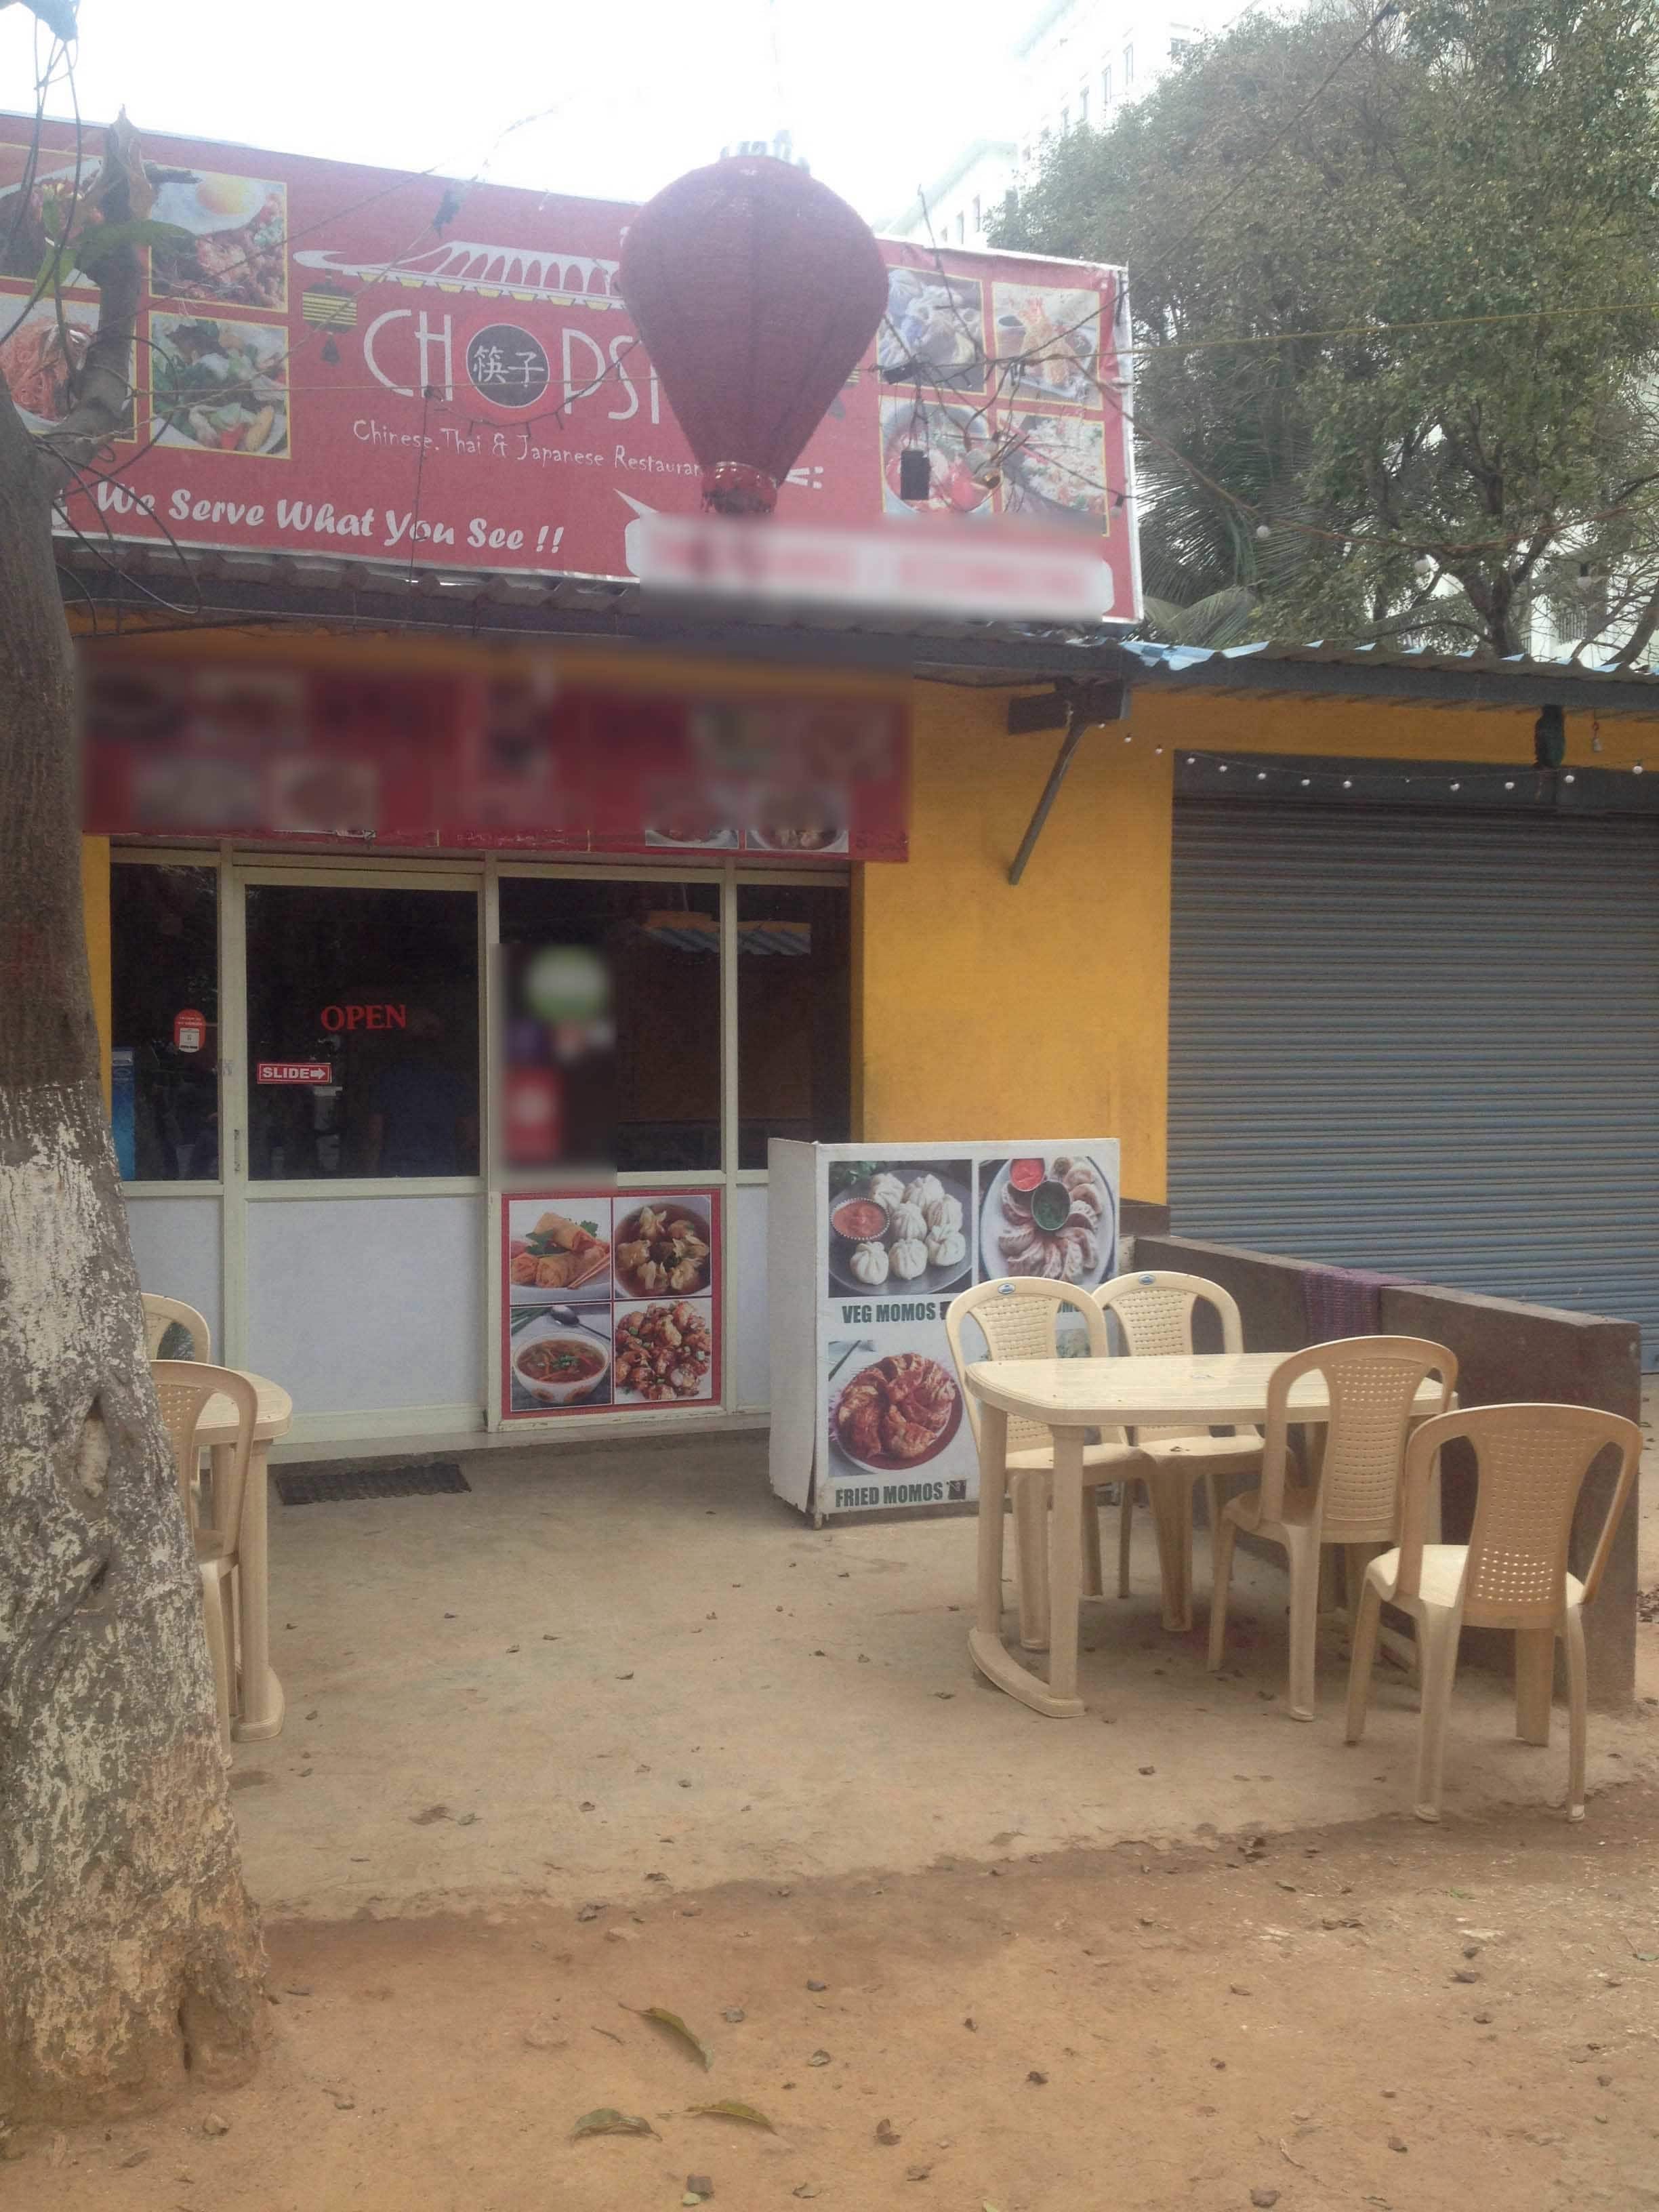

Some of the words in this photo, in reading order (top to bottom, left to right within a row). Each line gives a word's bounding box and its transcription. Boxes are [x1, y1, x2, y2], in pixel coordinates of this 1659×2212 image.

[473, 344, 545, 388] 筷子
[441, 428, 482, 455] Thai
[493, 432, 508, 458] &
[516, 434, 605, 467] Japanese
[614, 445, 705, 477] Restauran
[98, 480, 156, 515] We
[168, 489, 265, 526] Serve
[276, 499, 375, 536] What
[384, 510, 455, 546] You
[467, 518, 524, 550] See
[536, 525, 565, 554] !!
[321, 1004, 406, 1031] OPEN
[262, 1067, 310, 1080] SLIDE
[842, 1305, 872, 1323] VEG
[876, 1303, 936, 1322] MOMOS
[836, 1487, 880, 1508] FRIED
[883, 1481, 943, 1504] MOMOS
